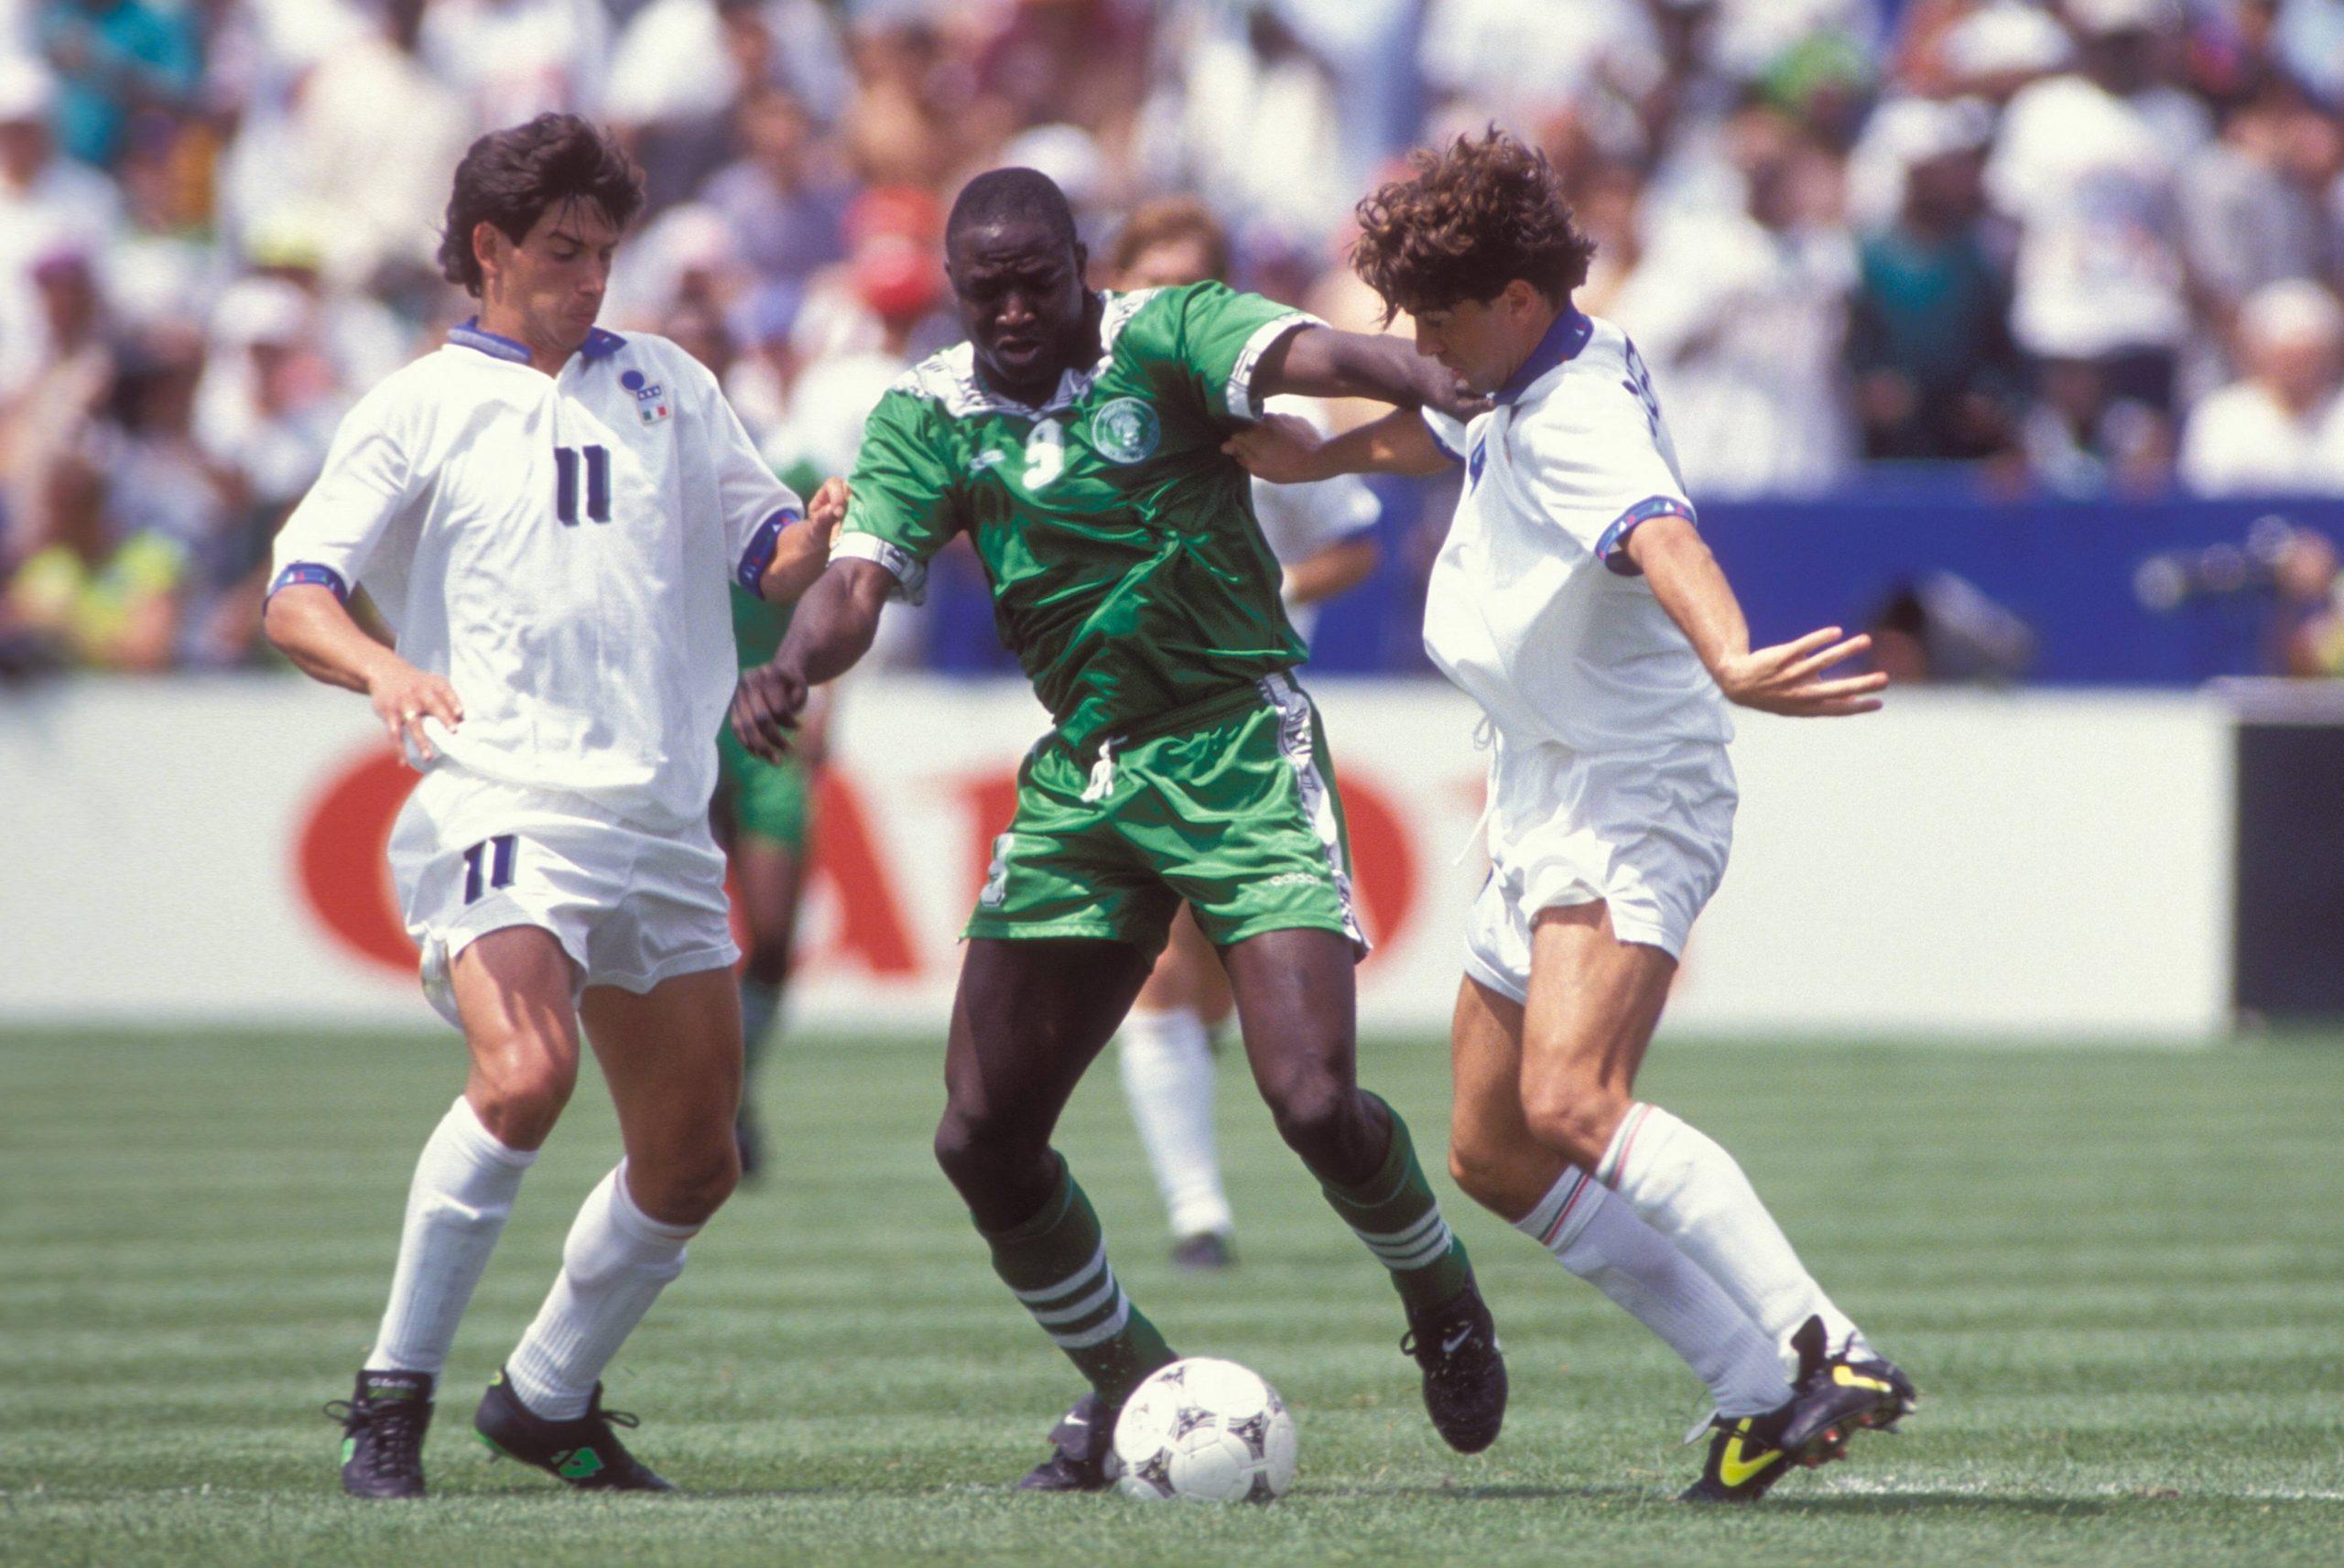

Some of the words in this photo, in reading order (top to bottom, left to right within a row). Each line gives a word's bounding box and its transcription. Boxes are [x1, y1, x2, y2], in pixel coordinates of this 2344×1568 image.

[553, 445, 612, 526] 11
[1023, 418, 1064, 490] 9
[463, 834, 519, 905] 11
